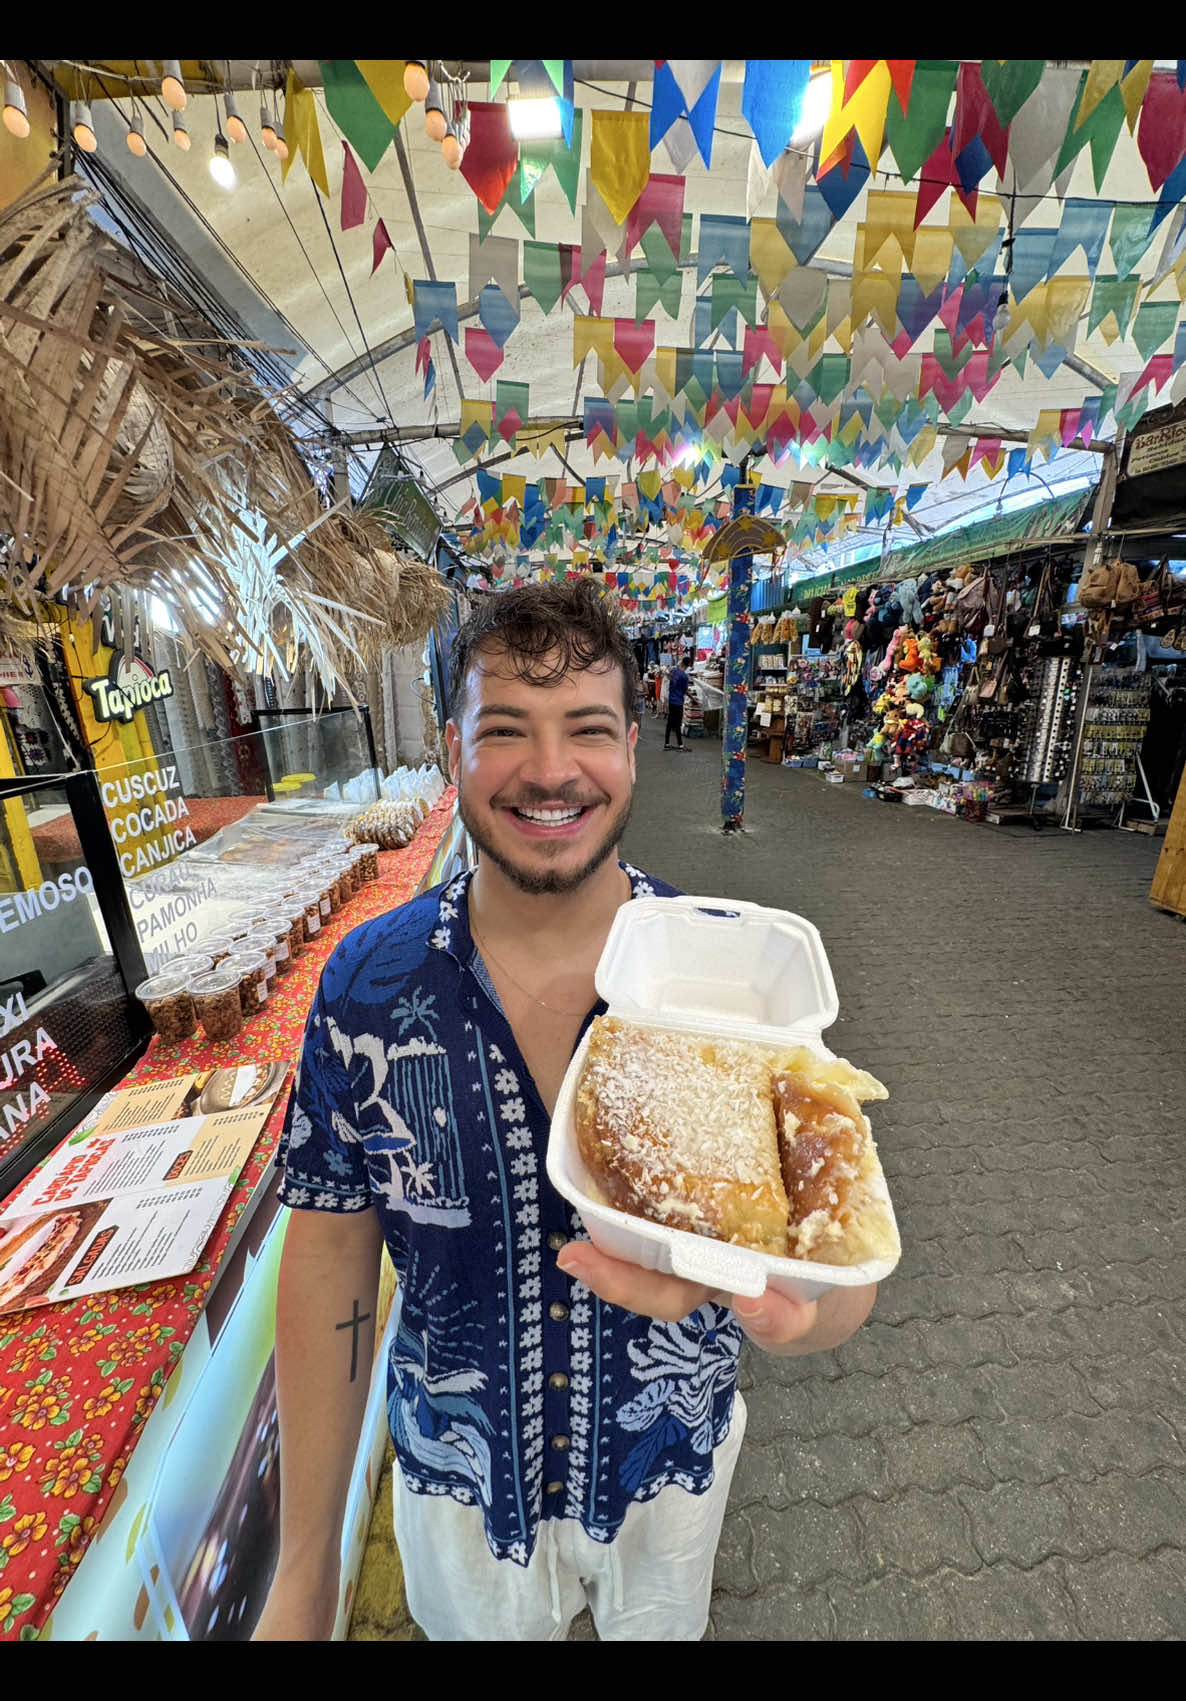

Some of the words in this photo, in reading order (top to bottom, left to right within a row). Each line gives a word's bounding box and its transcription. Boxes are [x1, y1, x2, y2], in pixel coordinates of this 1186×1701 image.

[90, 672, 173, 719] Tapioca
[101, 765, 180, 808] CUSCUZ
[111, 796, 190, 843] COCADA
[119, 826, 198, 878] CANJICA
[136, 877, 217, 944] PAMONHA
